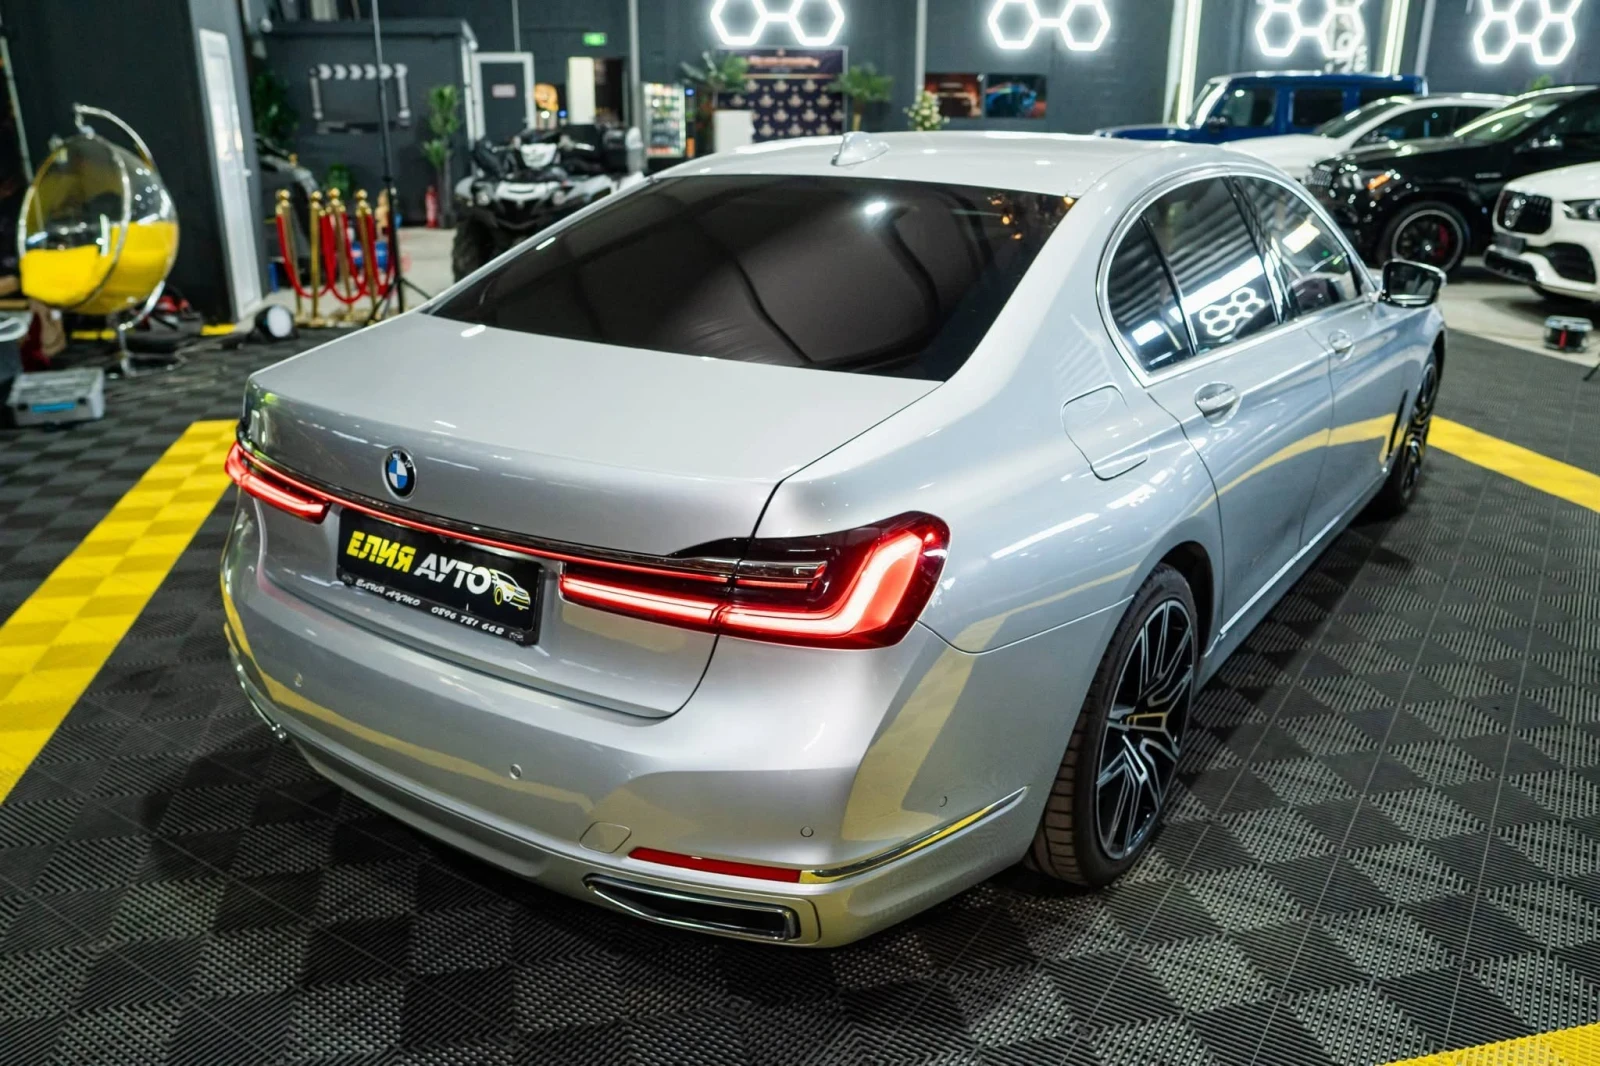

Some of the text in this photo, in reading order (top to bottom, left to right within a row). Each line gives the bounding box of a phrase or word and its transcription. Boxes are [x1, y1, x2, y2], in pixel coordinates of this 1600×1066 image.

[346, 530, 492, 595] ЕЛИЯ АУТО
[431, 606, 457, 620] 0896
[460, 615, 479, 627] 781
